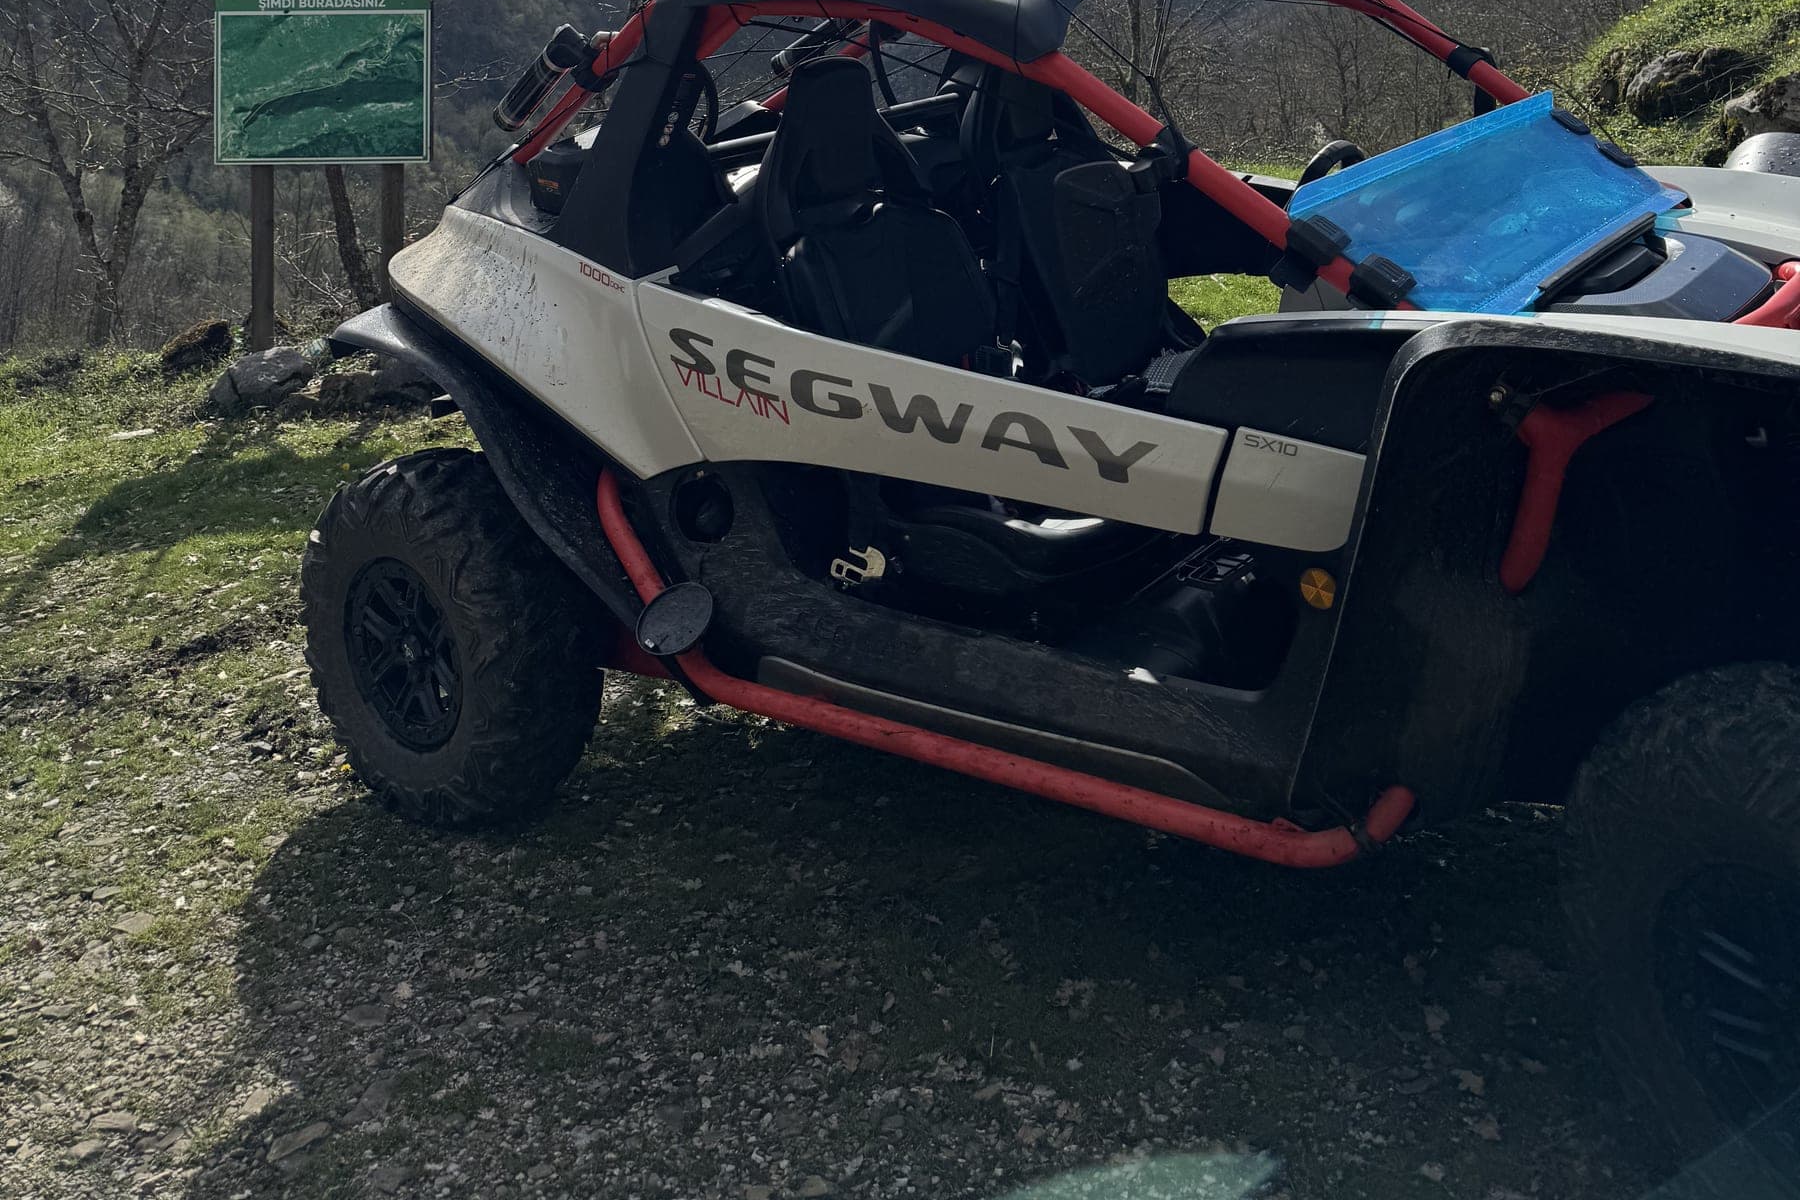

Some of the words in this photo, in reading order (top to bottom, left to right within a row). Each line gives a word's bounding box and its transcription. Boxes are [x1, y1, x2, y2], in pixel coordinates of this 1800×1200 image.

[578, 261, 610, 287] 1000
[669, 328, 1158, 483] SEGWAY
[673, 361, 790, 425] VILLAIN
[1243, 434, 1298, 457] SX10
